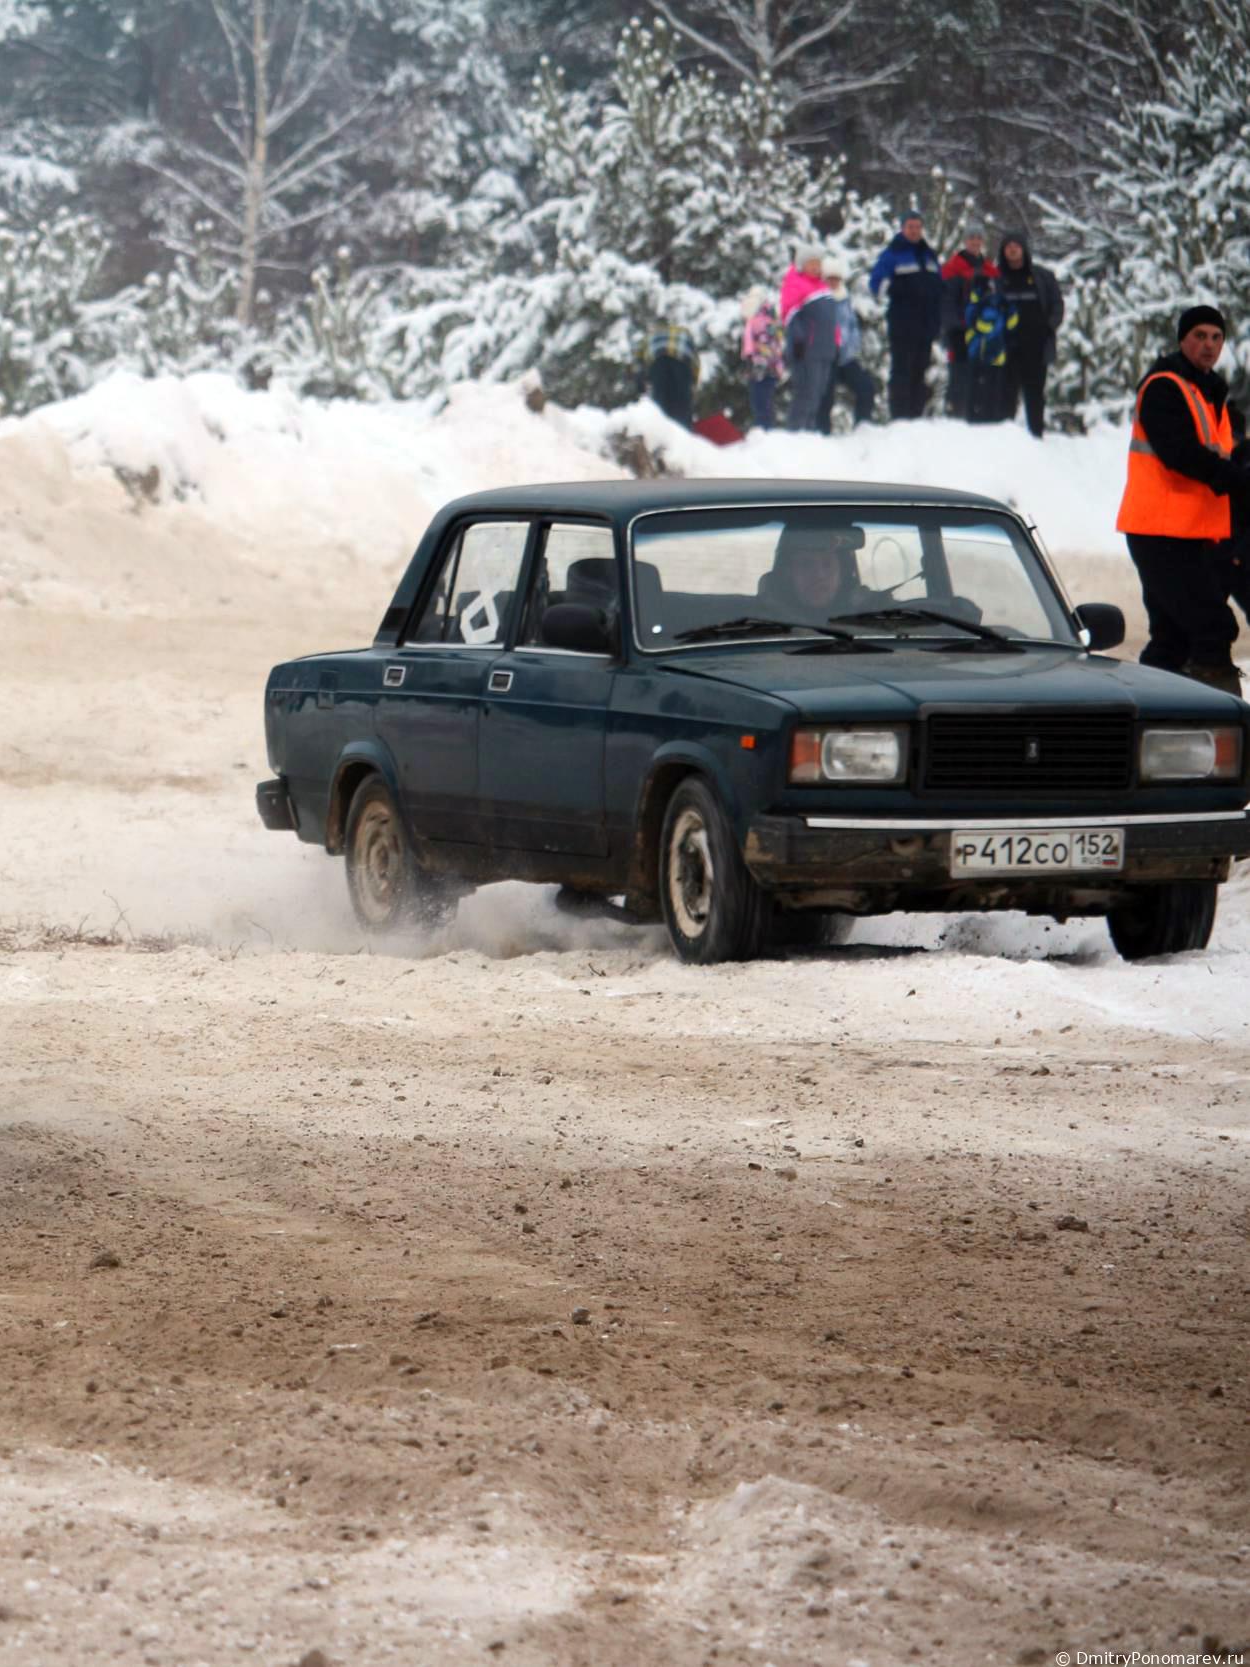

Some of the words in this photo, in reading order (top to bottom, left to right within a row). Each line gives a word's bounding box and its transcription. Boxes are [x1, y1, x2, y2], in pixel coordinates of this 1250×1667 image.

[962, 836, 1069, 866] Р412СО
[1075, 833, 1115, 856] 152
[1081, 856, 1102, 865] RUS
